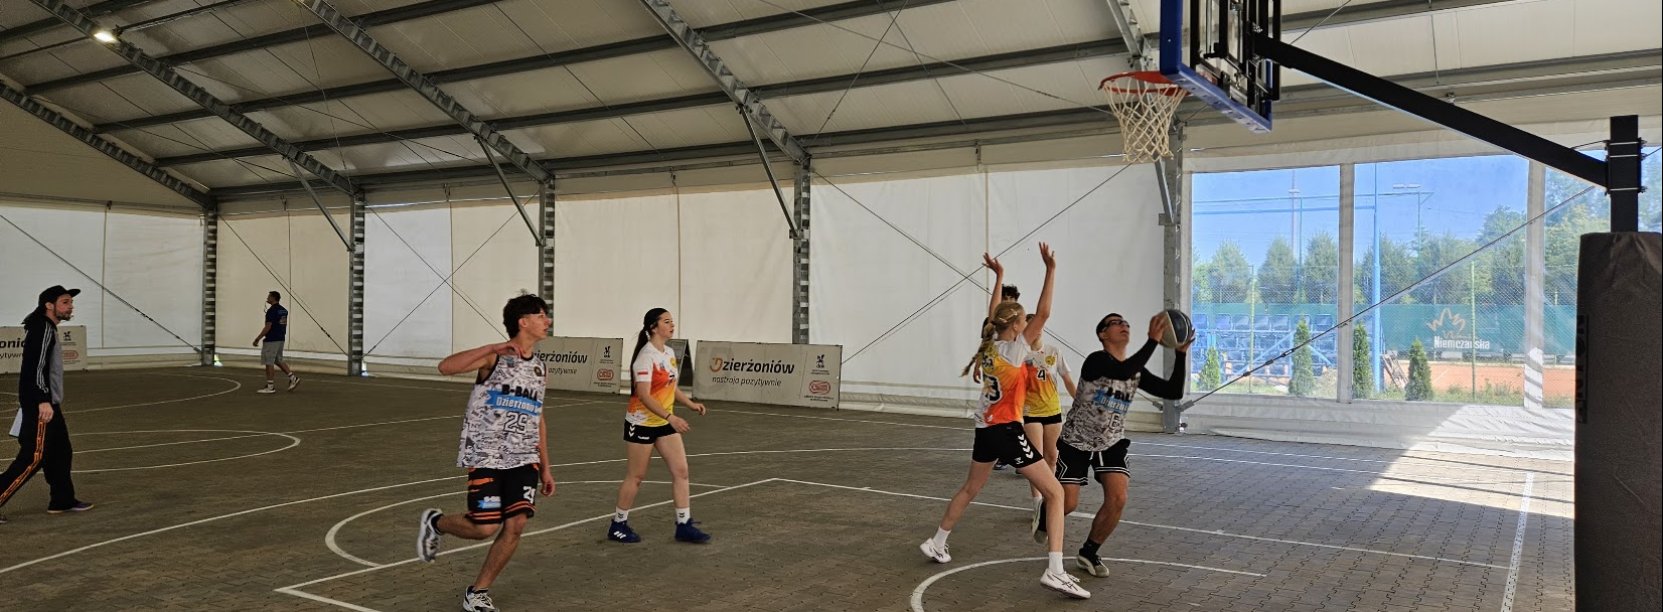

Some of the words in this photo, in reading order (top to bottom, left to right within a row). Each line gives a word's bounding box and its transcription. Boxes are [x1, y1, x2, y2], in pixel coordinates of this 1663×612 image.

[710, 357, 795, 374] Dzierżoniów
[1037, 369, 1046, 381] 4
[712, 376, 740, 386] nastraja
[741, 378, 782, 388] pozytywnie
